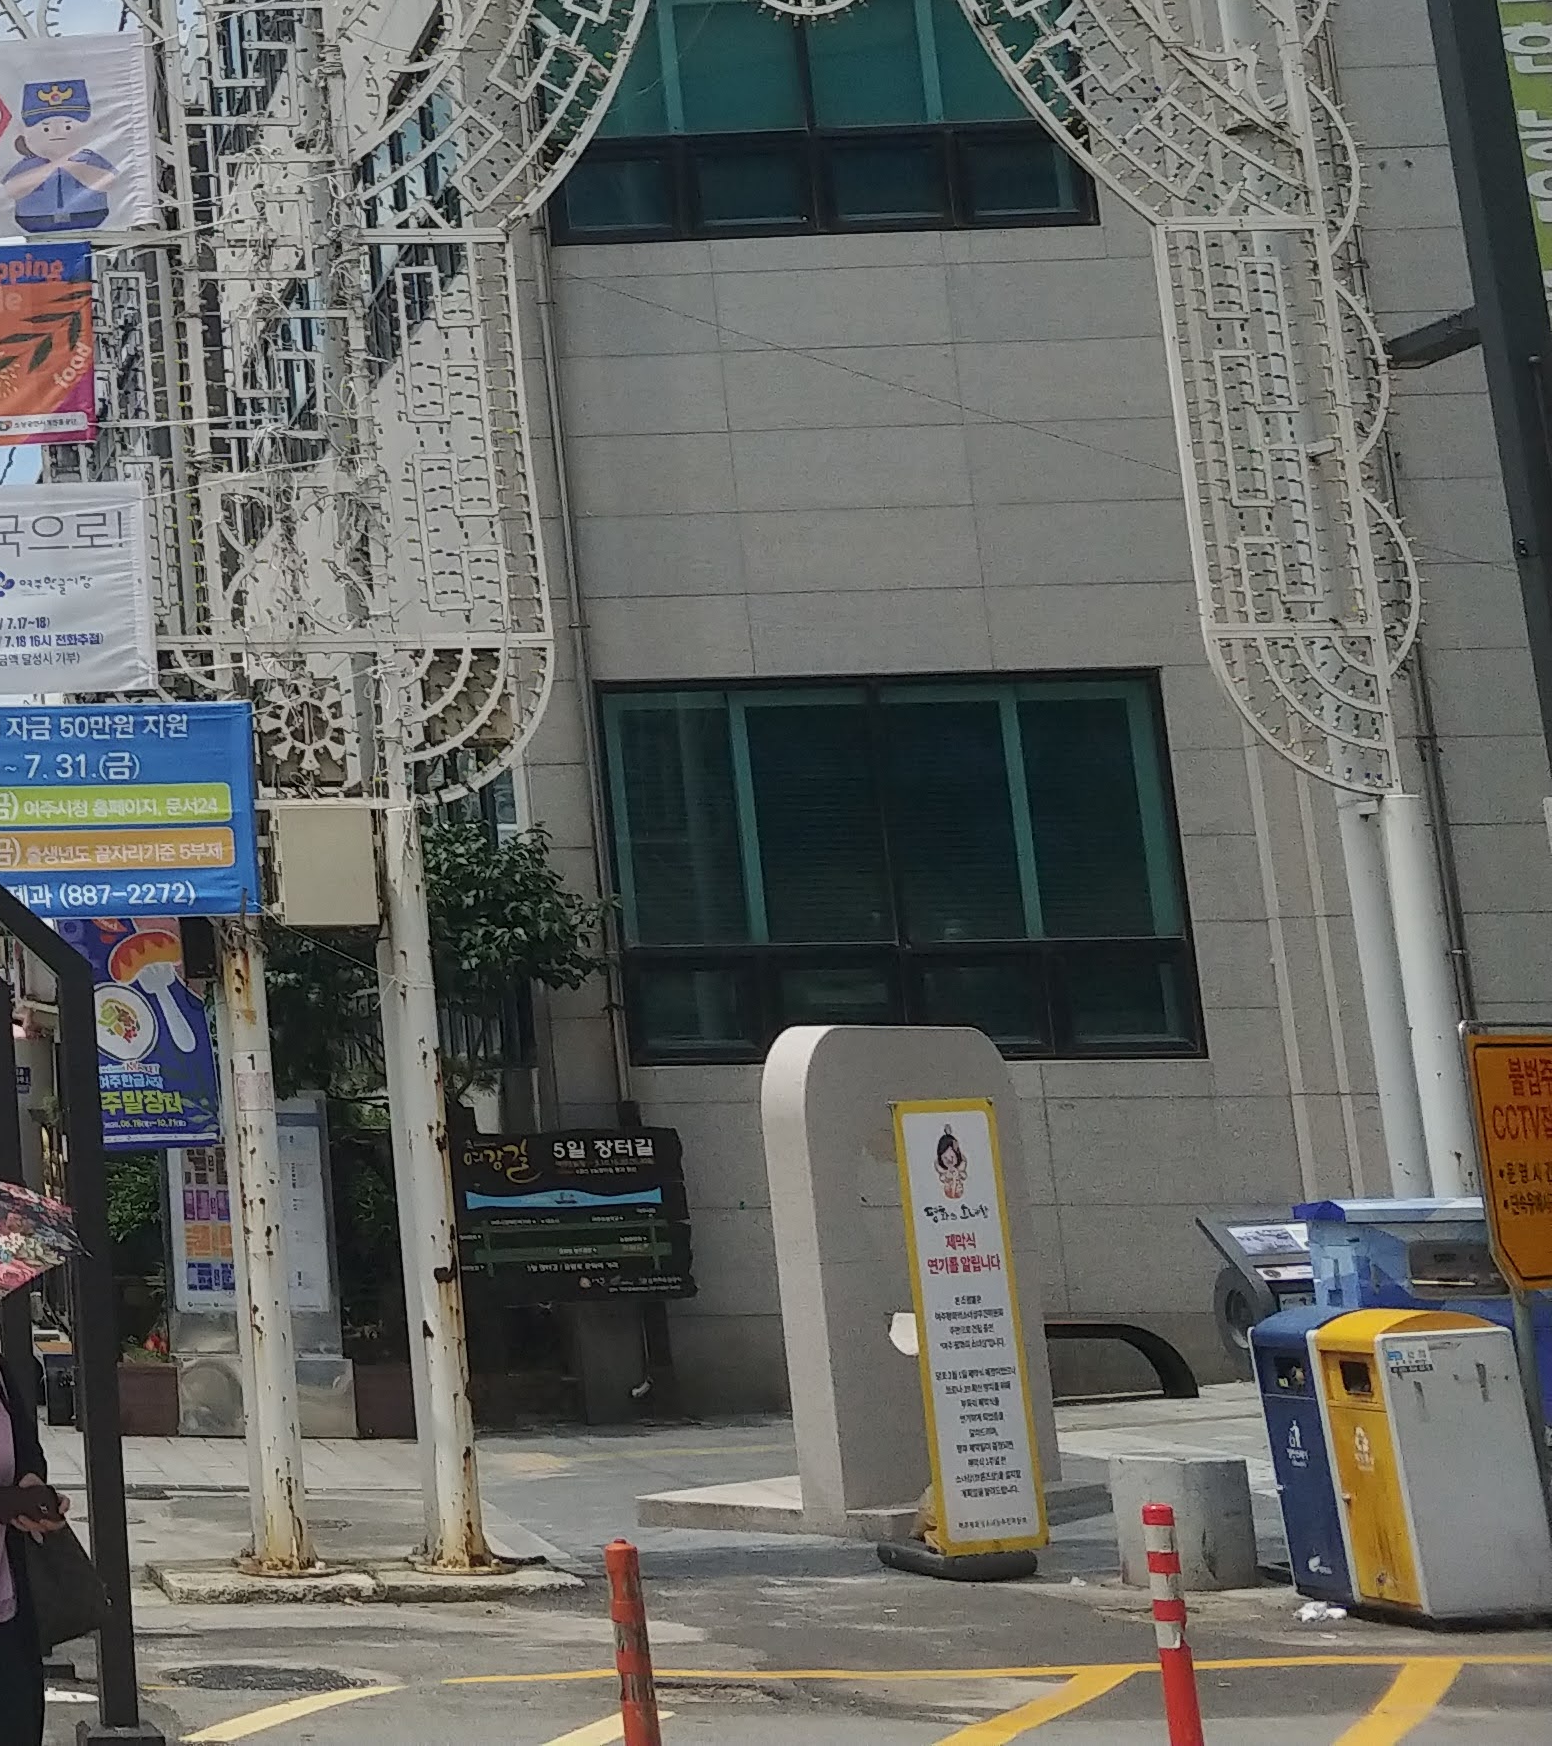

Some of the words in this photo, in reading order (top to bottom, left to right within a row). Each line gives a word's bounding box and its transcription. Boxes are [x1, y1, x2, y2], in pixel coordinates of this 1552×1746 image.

[19, 575, 93, 596] 여주한글시장
[6, 717, 52, 741] 자금
[59, 716, 135, 738] 50만원
[142, 714, 189, 738] 지원
[56, 752, 141, 782] 31.(금)
[23, 800, 88, 819] 여주시청
[166, 797, 218, 816] 문서24
[178, 842, 223, 860] 5부제
[59, 880, 196, 907] (887-2272)
[100, 1091, 183, 1115] 주말장터
[553, 1140, 586, 1159] 5일
[594, 1138, 654, 1157] 장터길
[945, 1232, 976, 1250] 제막식
[927, 1257, 959, 1274] 연기를
[961, 1254, 1001, 1274] 알립니다
